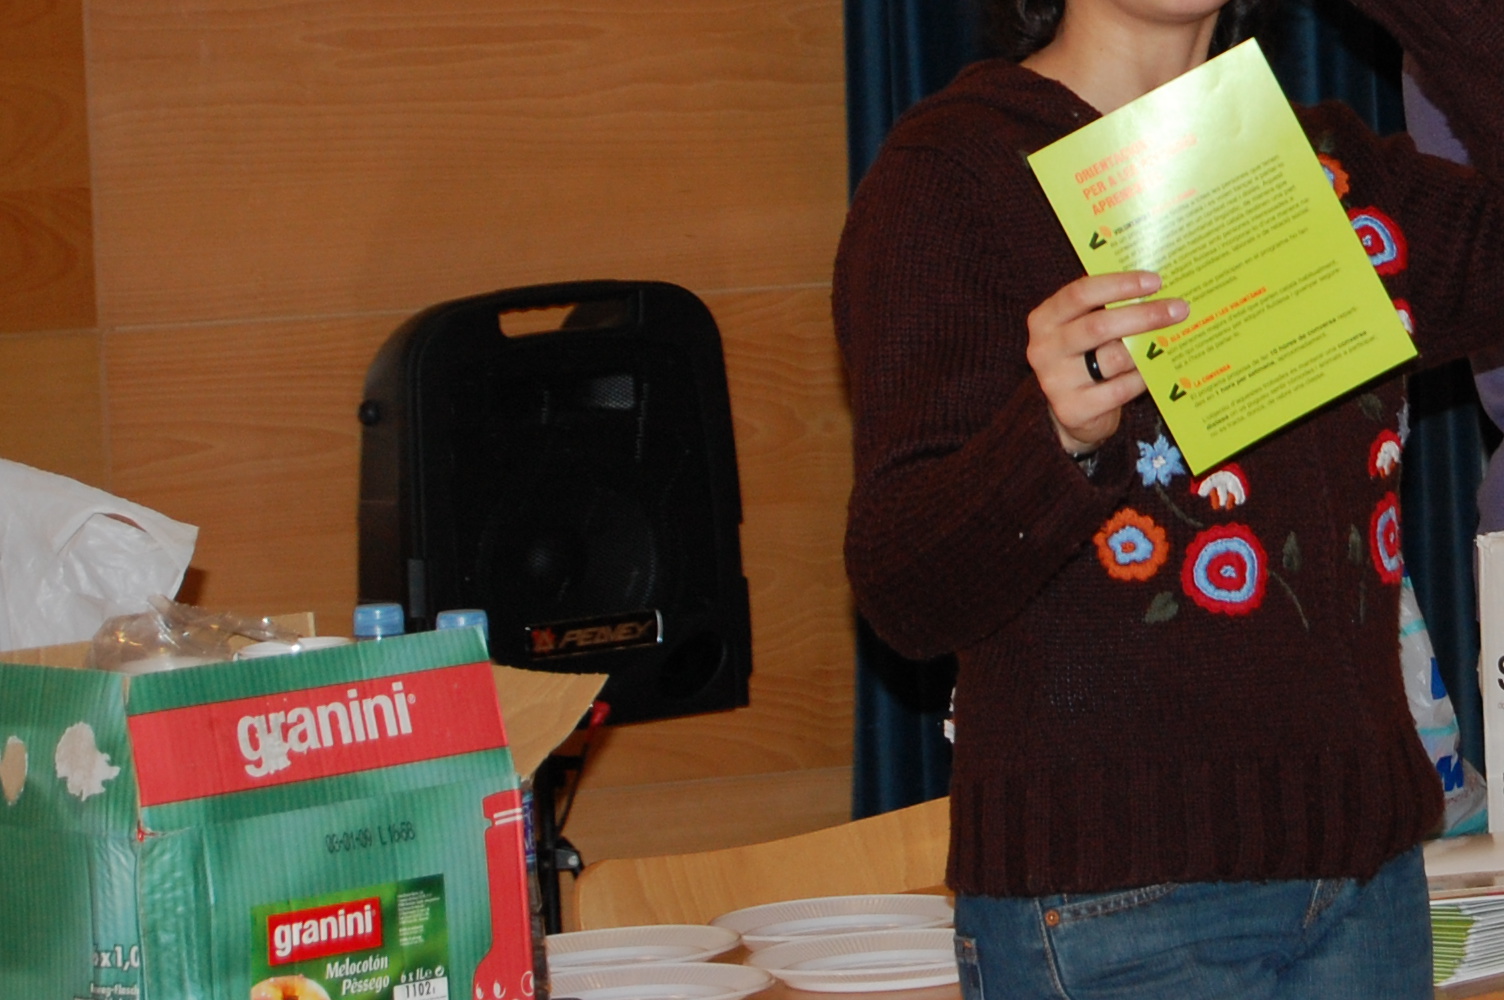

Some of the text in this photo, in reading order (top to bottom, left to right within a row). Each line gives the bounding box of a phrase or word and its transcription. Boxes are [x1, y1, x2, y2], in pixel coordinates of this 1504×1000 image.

[1082, 179, 1108, 201] PER
[1106, 174, 1118, 187] A
[559, 620, 653, 648] PEAVEY
[237, 681, 413, 778] granini
[274, 905, 373, 957] granini
[326, 954, 389, 979] Melocotón
